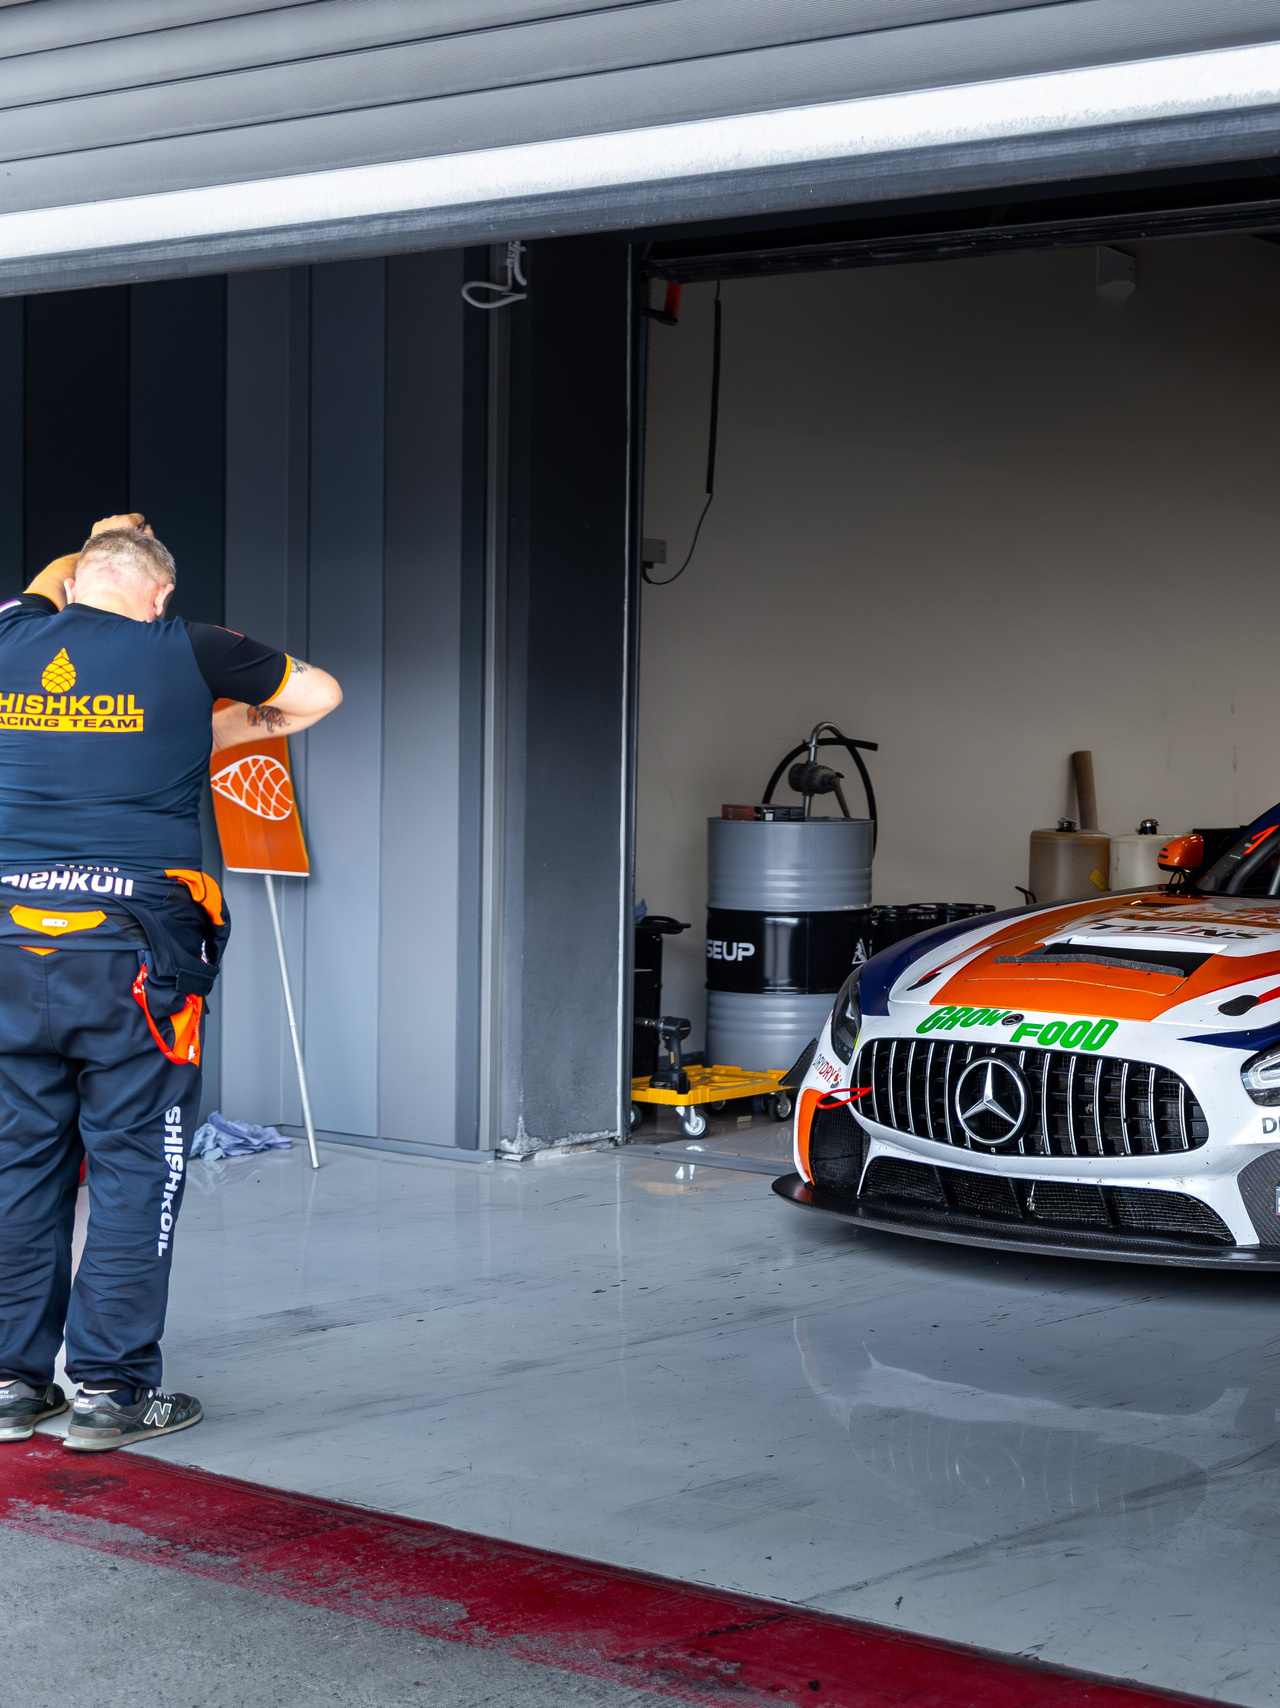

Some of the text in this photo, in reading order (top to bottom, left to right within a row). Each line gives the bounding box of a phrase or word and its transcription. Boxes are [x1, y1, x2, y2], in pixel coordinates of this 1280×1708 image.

[69, 718, 138, 729] TEAM
[916, 1005, 1119, 1052] GROW FOOD
[157, 1105, 184, 1257] SHISHKOIL
[143, 1400, 172, 1428] N
